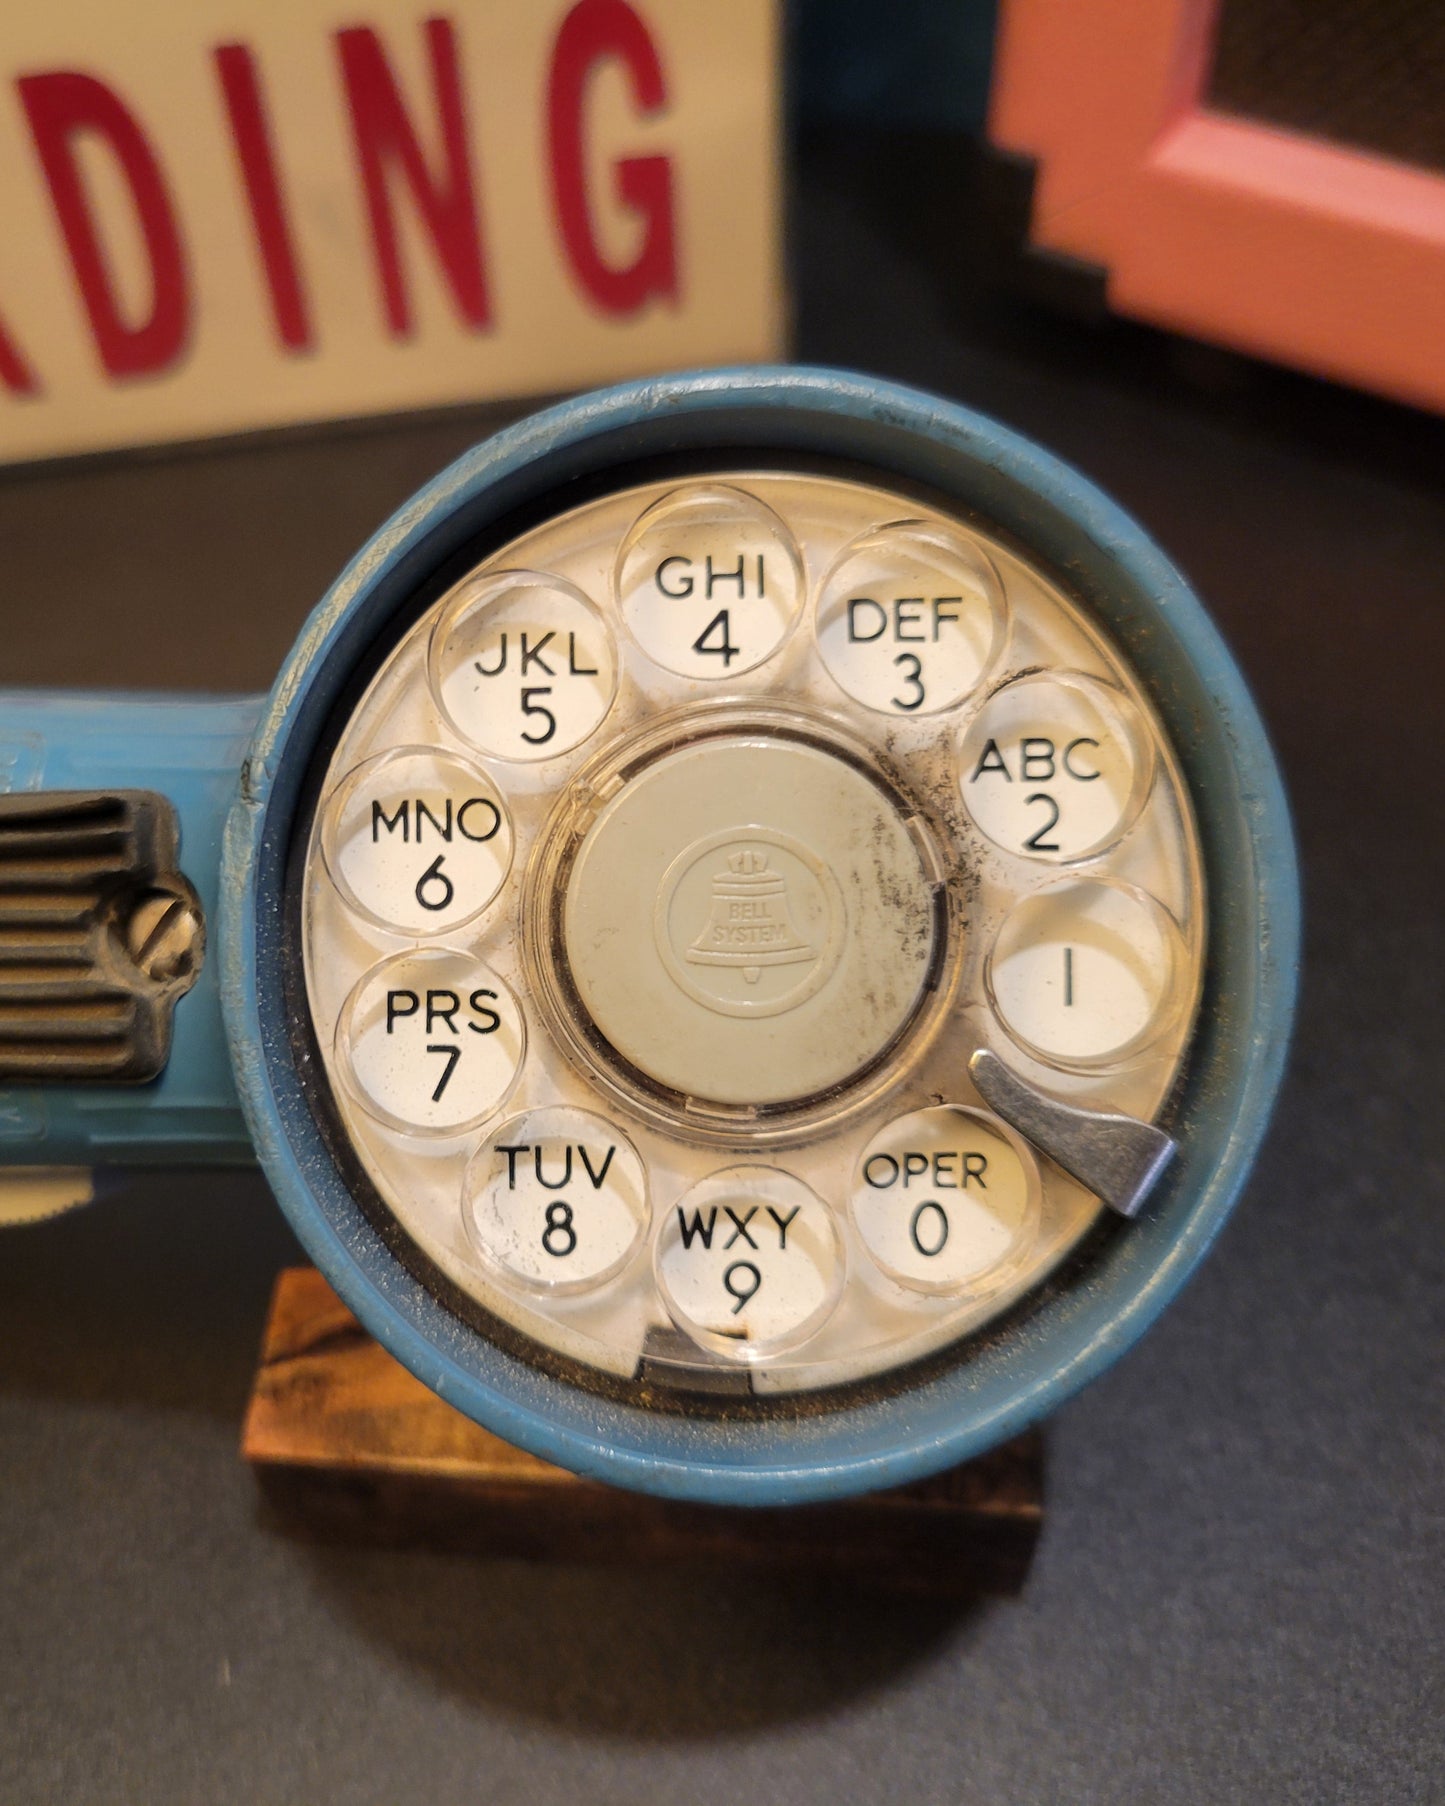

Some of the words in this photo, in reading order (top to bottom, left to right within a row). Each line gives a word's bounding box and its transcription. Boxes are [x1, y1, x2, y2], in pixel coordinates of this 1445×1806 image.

[0, 0, 683, 397] DING
[656, 555, 766, 600] GHI
[692, 609, 740, 667] 4
[847, 597, 962, 643] DEF
[474, 631, 599, 677] JKL
[892, 653, 925, 710] 3
[520, 687, 556, 745] 5
[971, 738, 1101, 784] ABC
[372, 798, 501, 843] MNO
[1023, 794, 1060, 852] 2
[415, 854, 454, 911] 6
[712, 924, 786, 943] SYSTEM
[729, 902, 771, 919] BELL
[386, 989, 501, 1035] PRS
[426, 1044, 462, 1102] 7
[495, 1145, 616, 1190] TUV
[862, 1152, 988, 1190] OPER
[541, 1201, 578, 1257] 8
[678, 1206, 800, 1251] WXY
[909, 1201, 950, 1257] 0
[723, 1261, 762, 1315] 9
